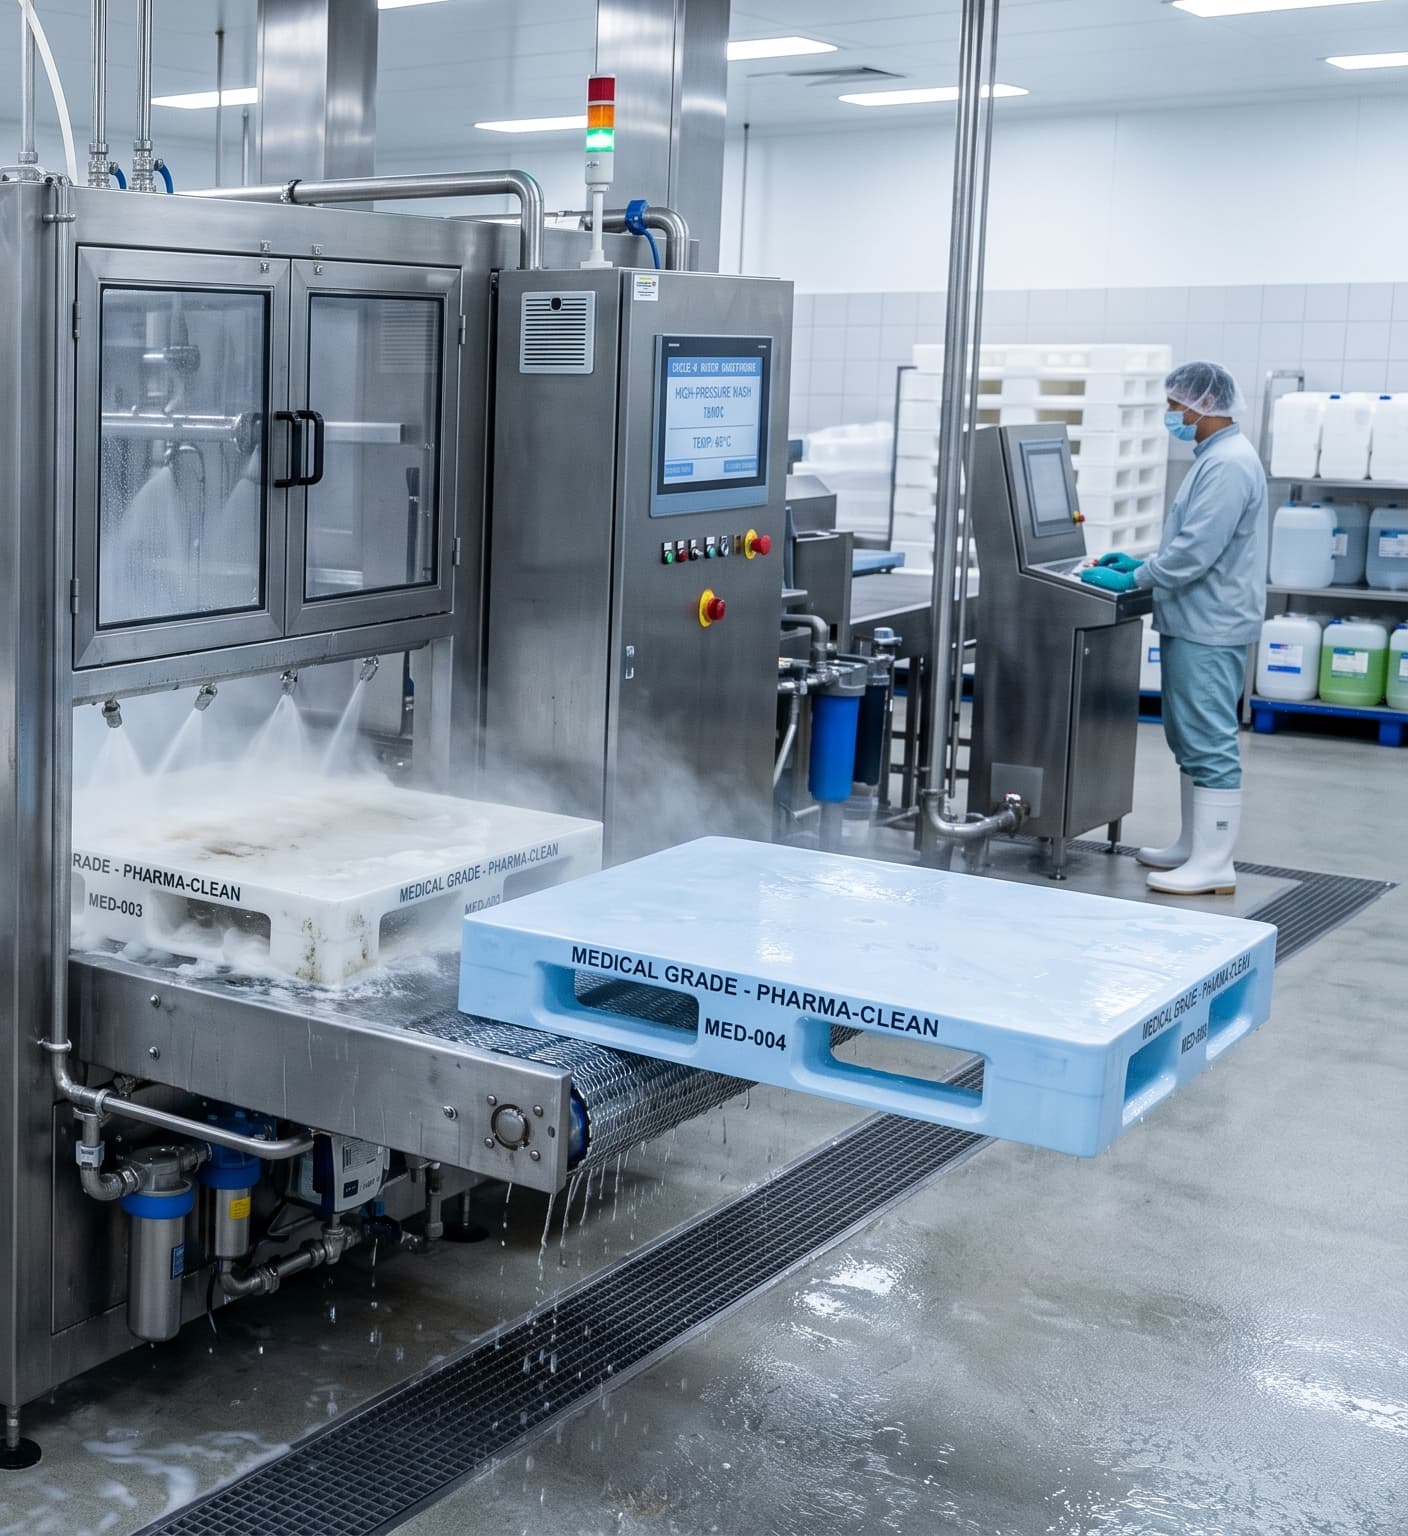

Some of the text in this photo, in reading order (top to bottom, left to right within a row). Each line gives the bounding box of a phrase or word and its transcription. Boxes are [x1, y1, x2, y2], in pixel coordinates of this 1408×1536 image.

[73, 852, 111, 874] RADE
[123, 863, 242, 902] PHARMA-CLEAN
[399, 878, 445, 903] MEDICAL
[447, 865, 481, 889] GRADE
[488, 843, 559, 876] PHARMA-CLEAN
[89, 892, 143, 918] MED-003
[571, 945, 659, 980] MEDICAL
[664, 965, 738, 997] GRADE
[757, 983, 940, 1038] PHARMA-CLEAN
[704, 1017, 787, 1051] MED-004
